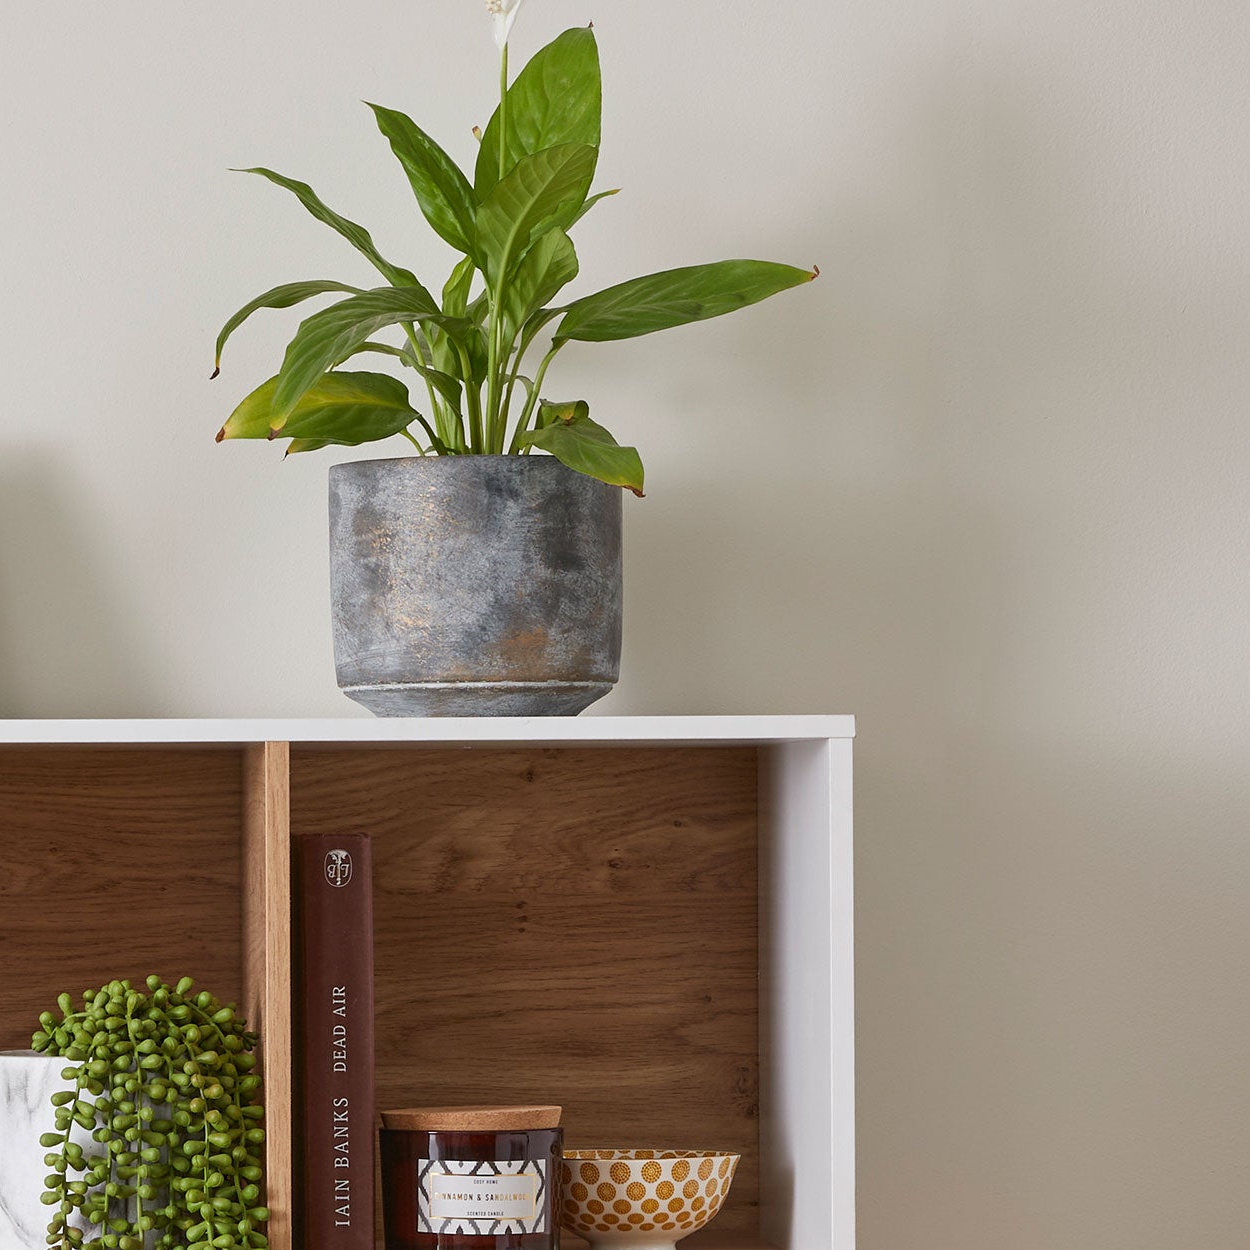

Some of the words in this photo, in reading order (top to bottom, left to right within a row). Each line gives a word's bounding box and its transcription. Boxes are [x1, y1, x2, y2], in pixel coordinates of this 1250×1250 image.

[332, 985, 346, 1017] AIR
[332, 1025, 347, 1073] DEAD
[333, 1097, 350, 1168] BANKS
[334, 1179, 351, 1227] IAIN
[434, 1192, 473, 1201] NNAMON
[476, 1193, 482, 1201] &
[485, 1193, 530, 1202] SANDALWOO
